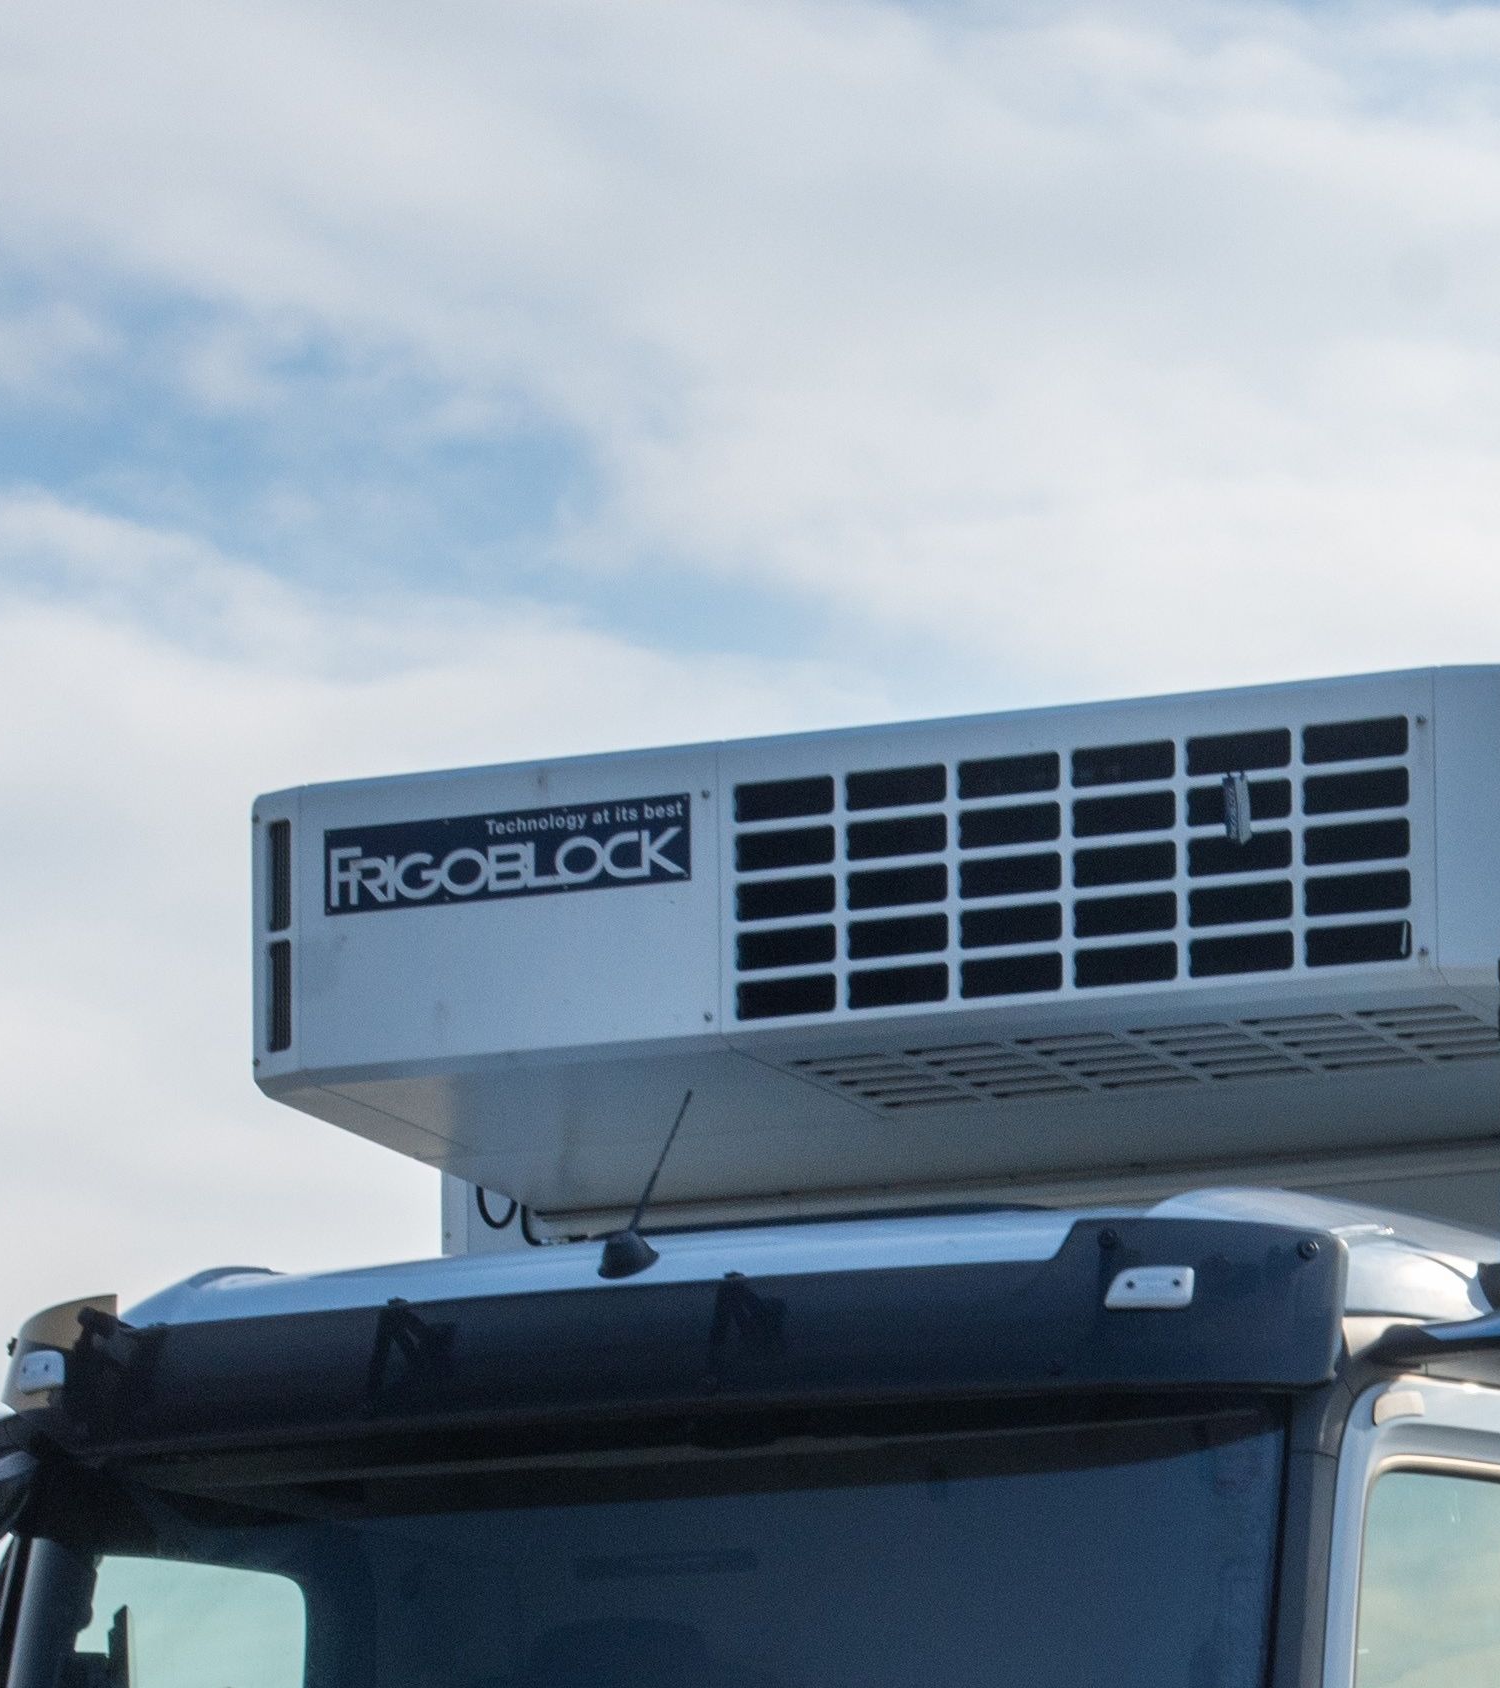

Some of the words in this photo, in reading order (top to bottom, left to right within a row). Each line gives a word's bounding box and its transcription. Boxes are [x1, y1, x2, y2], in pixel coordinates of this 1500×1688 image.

[485, 812, 587, 836] Technology
[592, 810, 610, 825] at
[614, 807, 638, 823] its
[643, 802, 684, 820] best
[330, 826, 687, 908] FRIGOBLOCK
